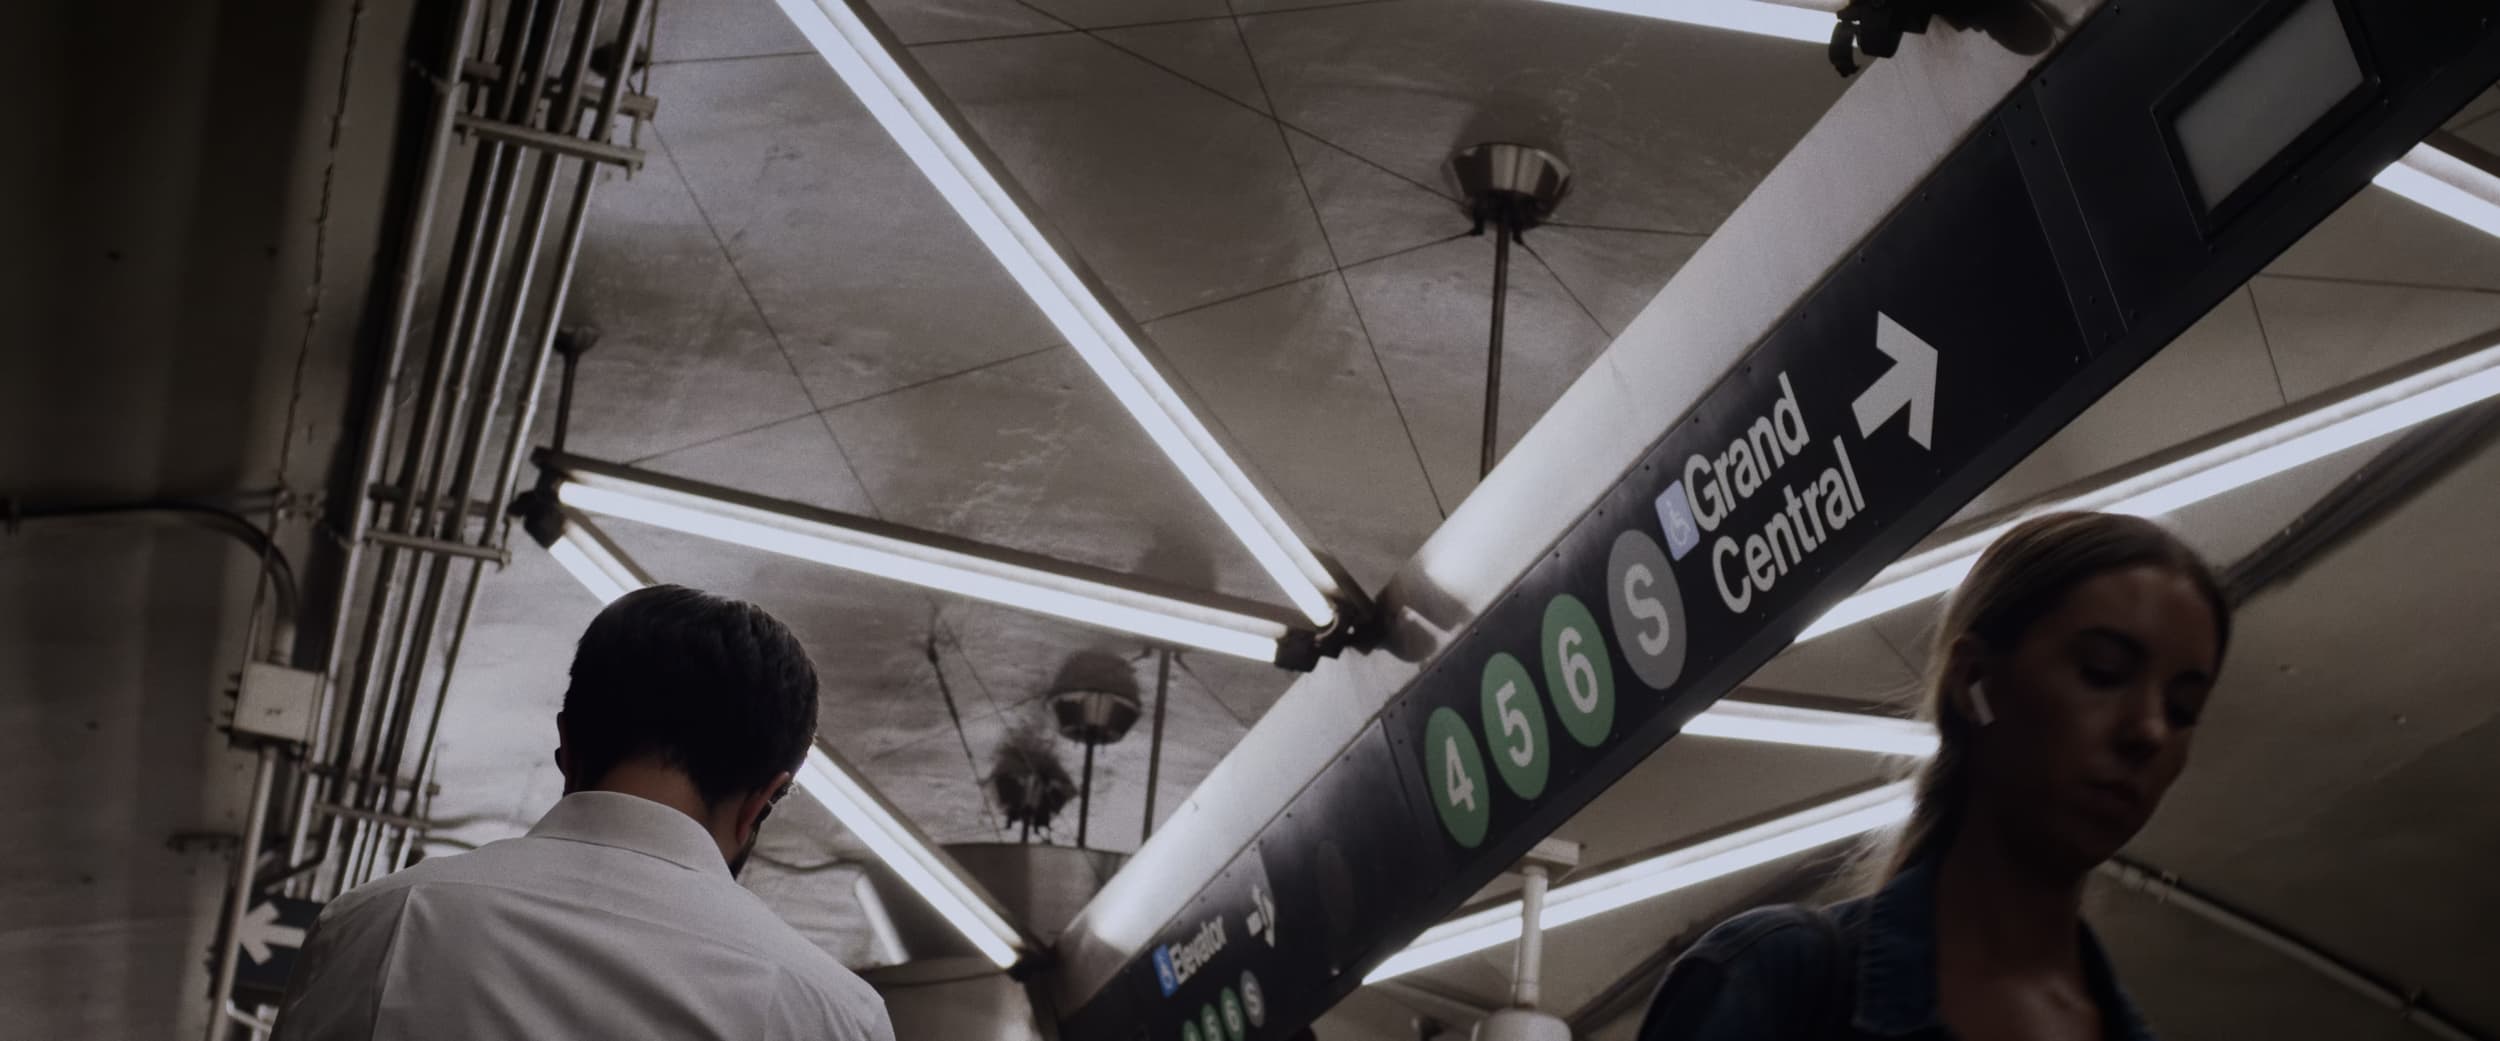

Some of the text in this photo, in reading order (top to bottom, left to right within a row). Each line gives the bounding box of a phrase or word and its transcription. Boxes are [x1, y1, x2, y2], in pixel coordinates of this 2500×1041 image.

[1684, 371, 1810, 532] Grand
[1711, 434, 1867, 615] Central
[1445, 562, 1671, 813] 4 5 6 S
[1168, 915, 1228, 985] Elevator
